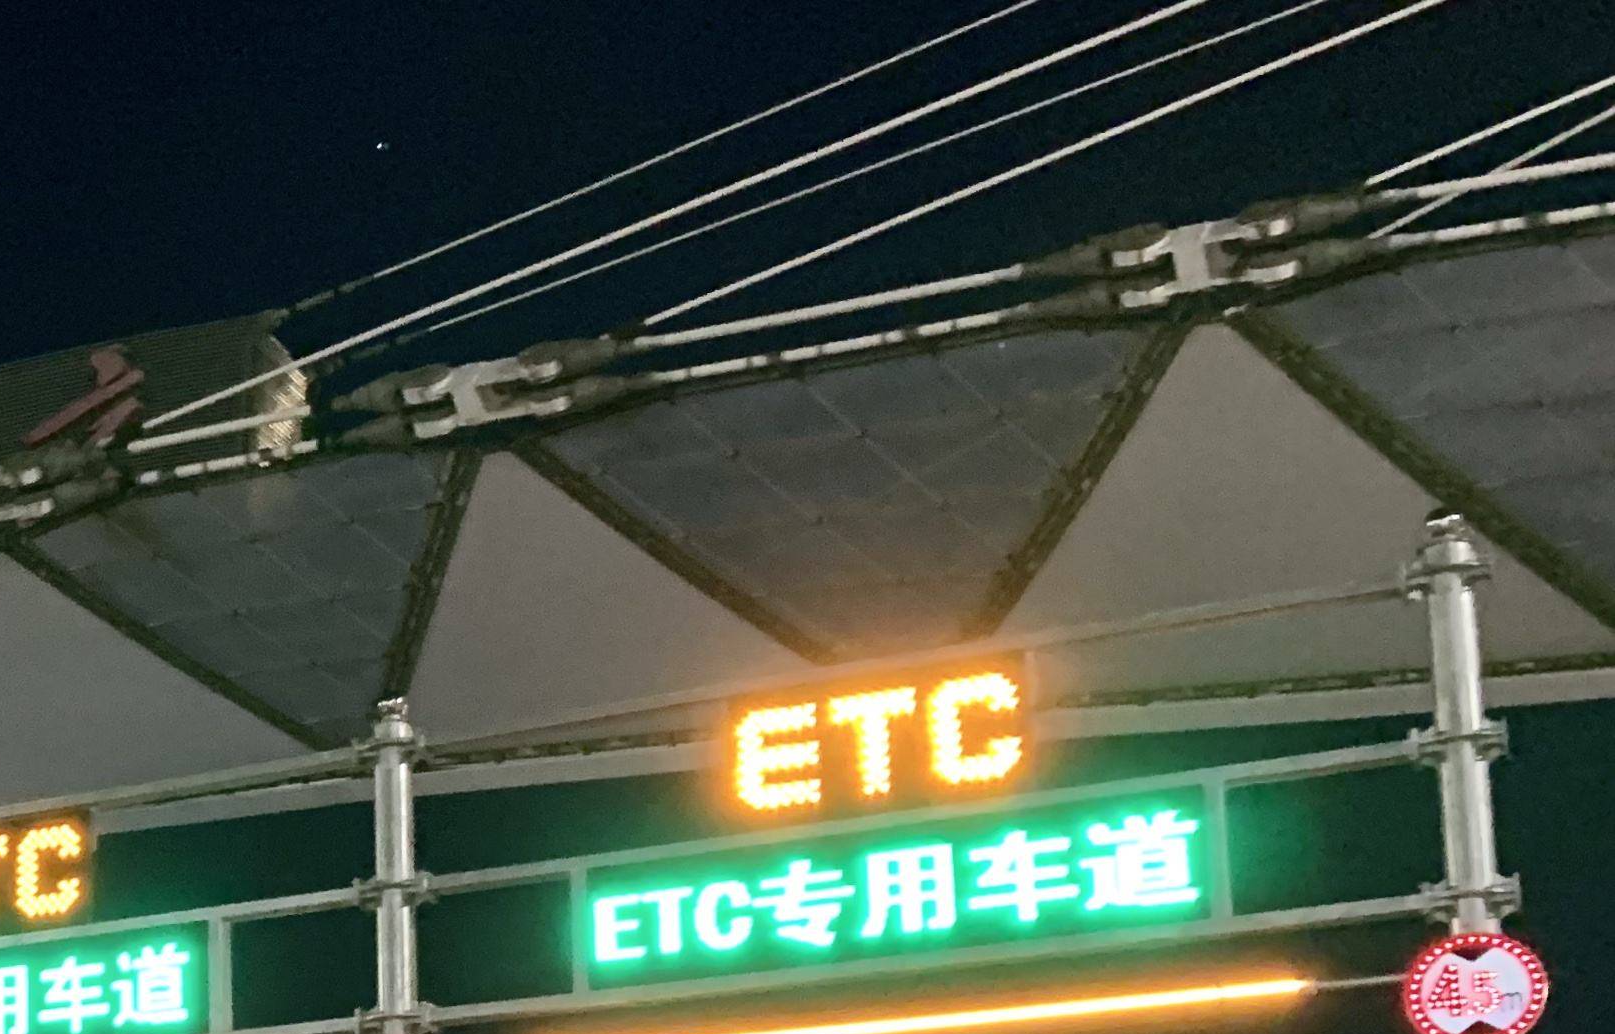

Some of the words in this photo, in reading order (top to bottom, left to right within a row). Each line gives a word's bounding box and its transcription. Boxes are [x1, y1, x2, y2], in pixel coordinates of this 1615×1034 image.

[733, 671, 1022, 810] ETC
[592, 809, 1199, 964] ETC专用车道
